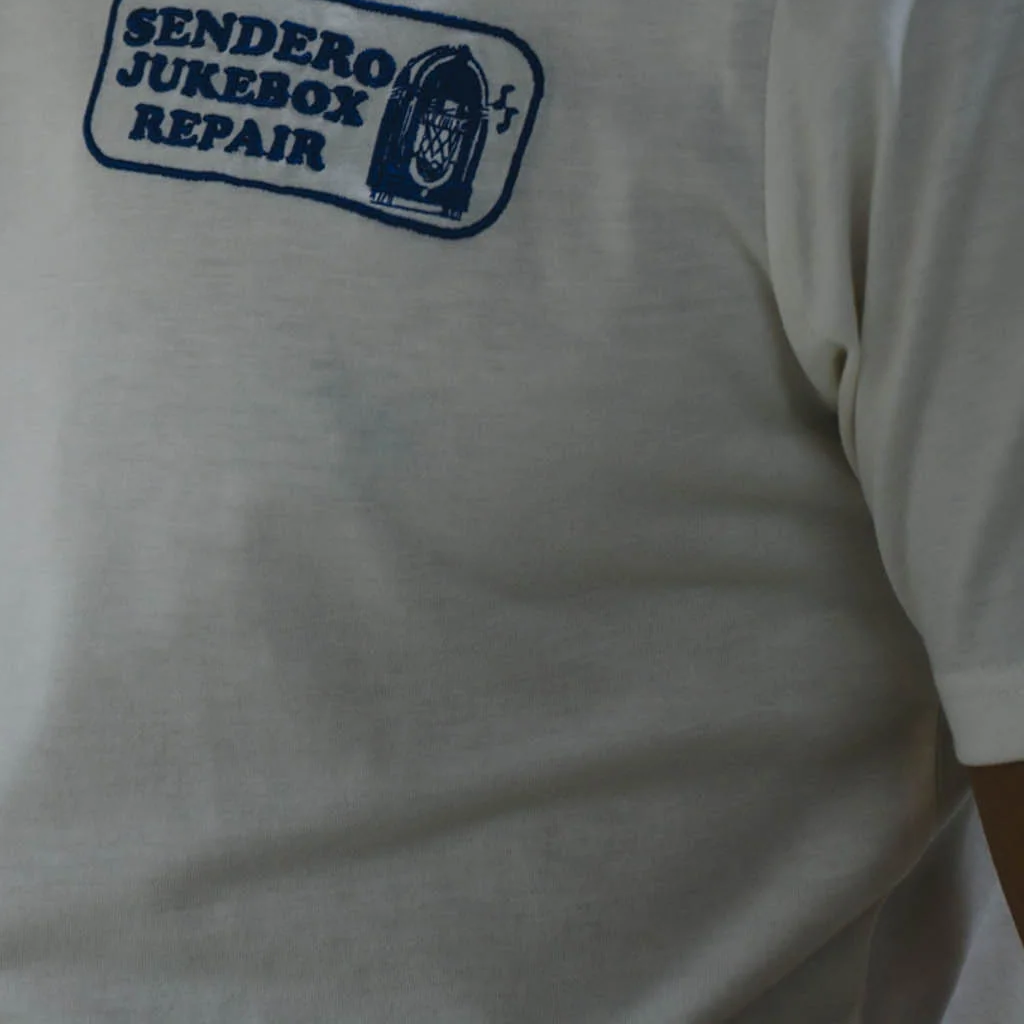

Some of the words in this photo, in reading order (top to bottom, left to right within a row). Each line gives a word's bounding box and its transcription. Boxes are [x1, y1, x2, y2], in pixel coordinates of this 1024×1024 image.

[123, 7, 397, 88] SENDERO
[116, 51, 369, 127] JUKEBOX
[128, 103, 326, 172] REPAIR
